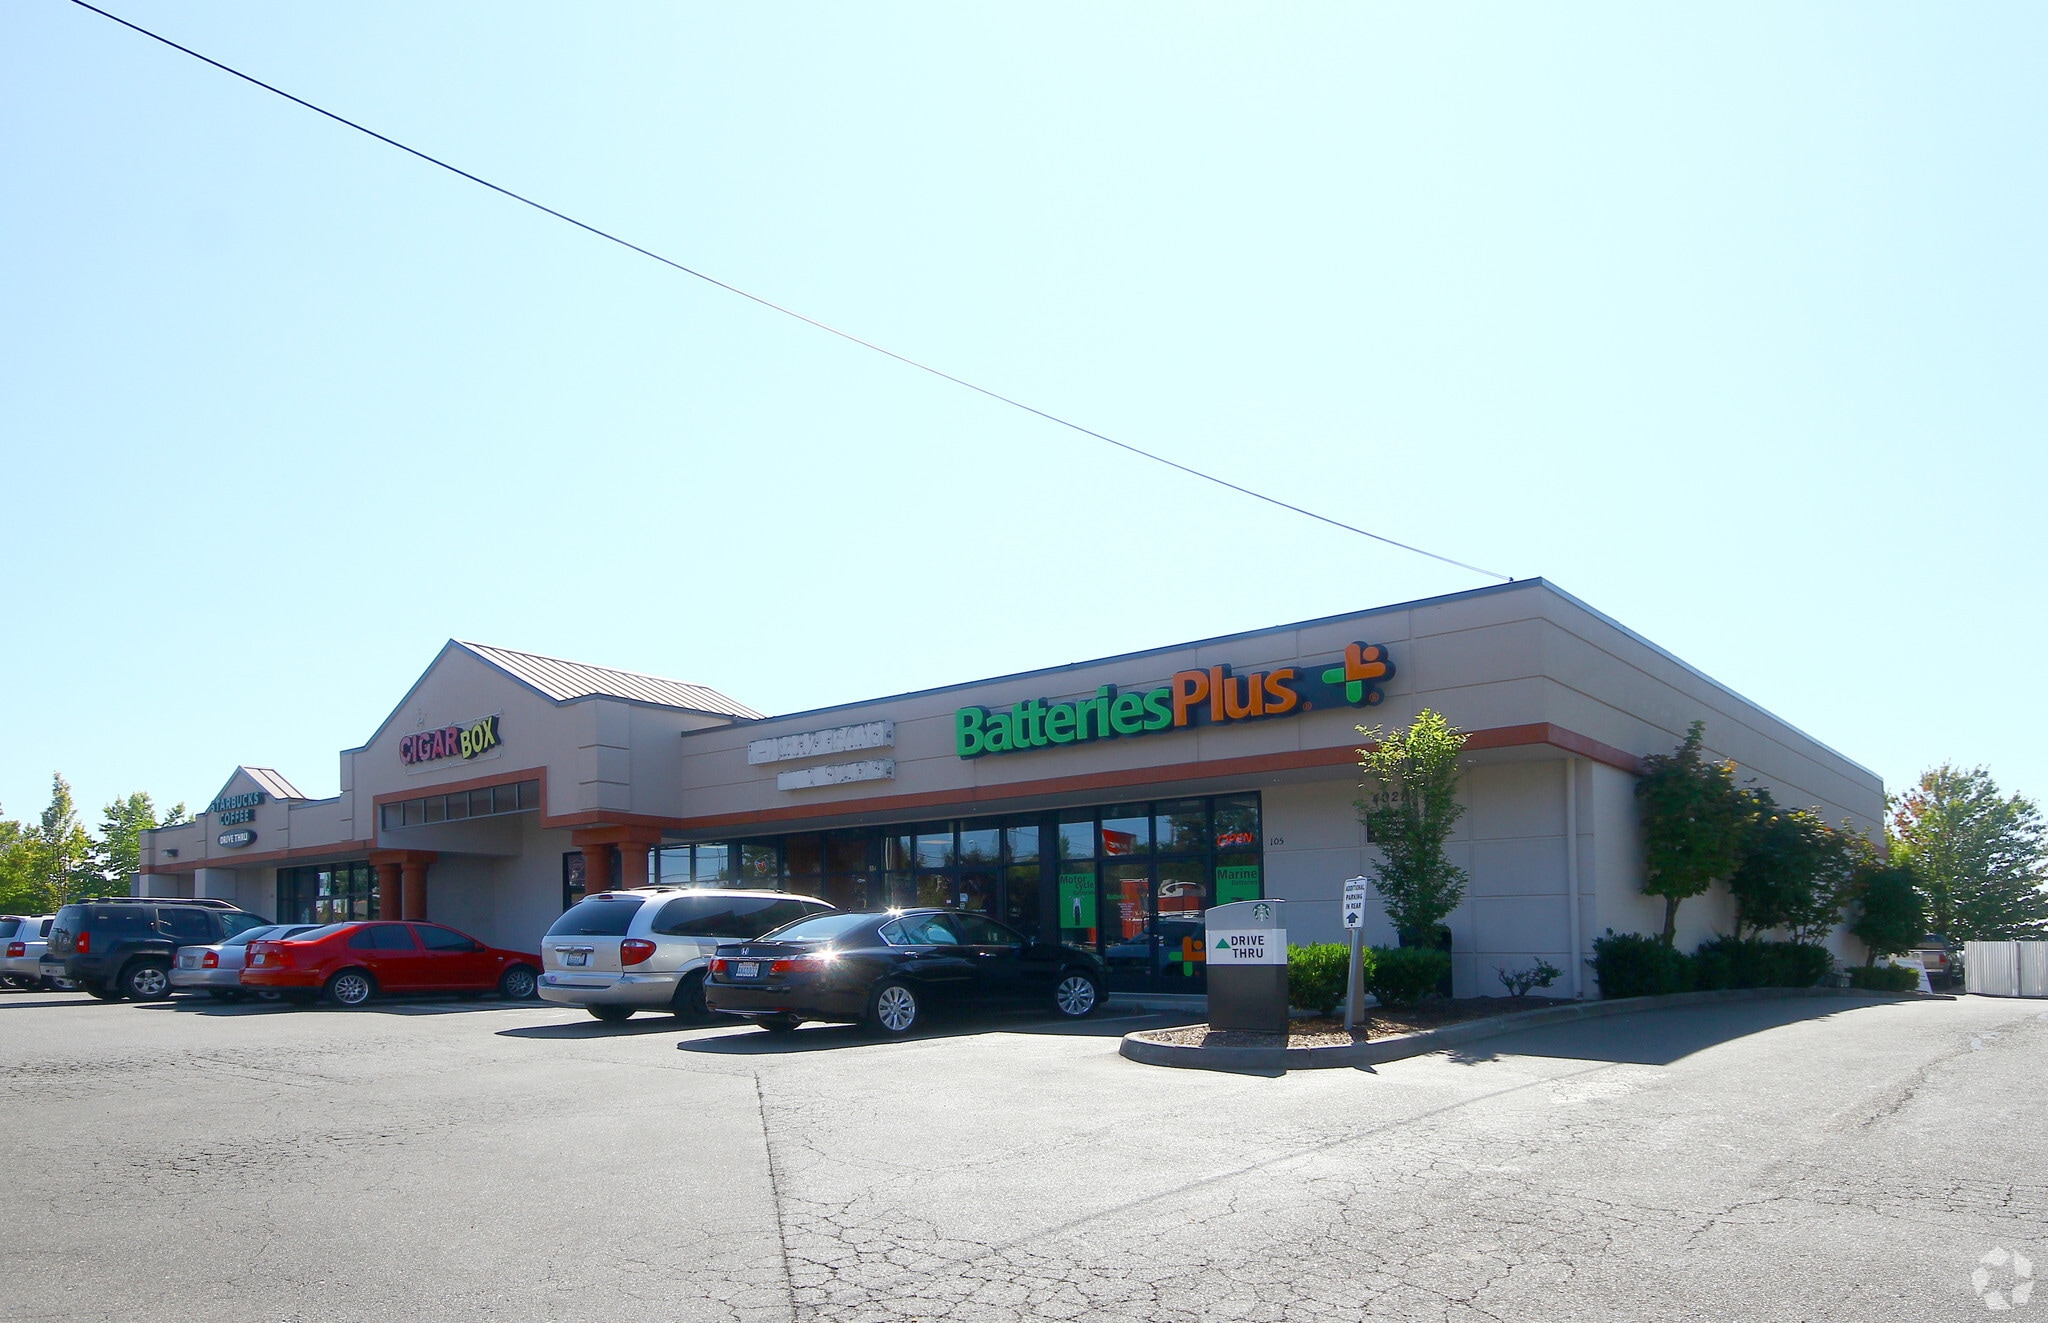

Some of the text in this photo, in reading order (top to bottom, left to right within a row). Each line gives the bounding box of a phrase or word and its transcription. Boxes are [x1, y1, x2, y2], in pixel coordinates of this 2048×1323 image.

[400, 716, 496, 765] CIGAR BOX
[210, 792, 259, 812] STARBUCKS
[220, 809, 249, 825] COFFEE
[220, 834, 234, 844] DRIVE
[1217, 832, 1253, 847] OPEN
[1270, 837, 1284, 846] 105
[1217, 868, 1257, 879] Marine
[1060, 875, 1086, 884] Motor
[1231, 936, 1264, 945] DRIVE
[1232, 948, 1263, 958] THRU
